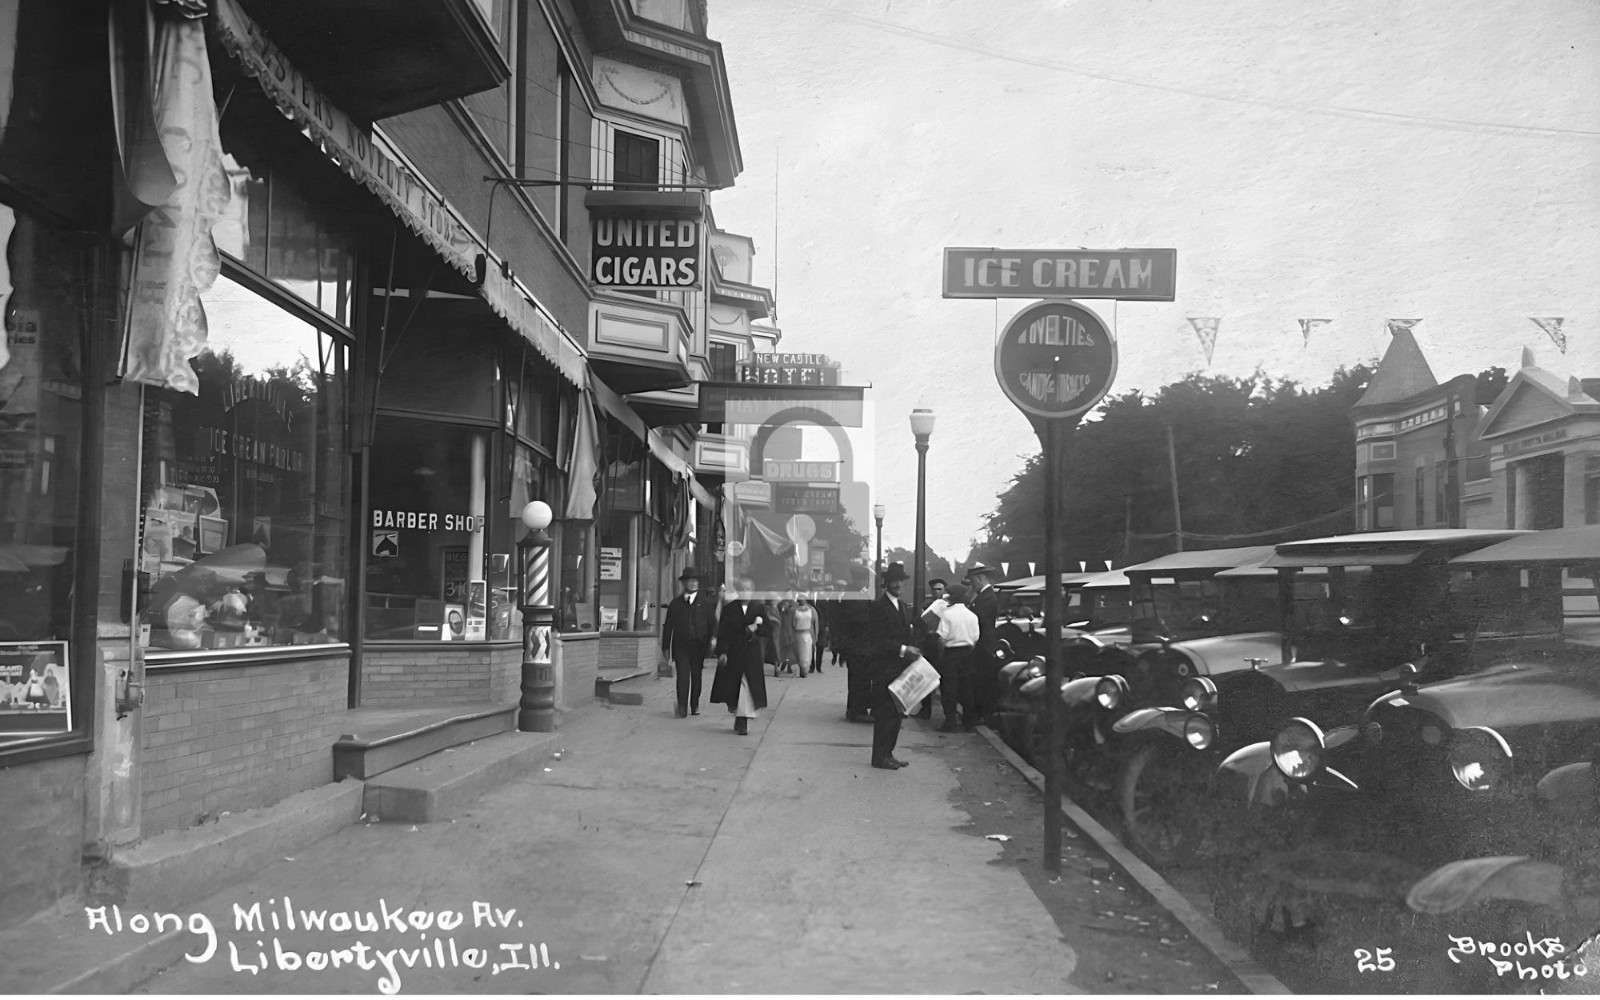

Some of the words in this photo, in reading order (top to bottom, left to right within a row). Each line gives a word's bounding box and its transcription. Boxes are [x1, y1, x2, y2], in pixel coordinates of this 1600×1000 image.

[346, 121, 412, 205] NOVELTY
[597, 219, 695, 247] UNITED
[596, 256, 695, 285] CIGARS
[964, 258, 1021, 287] ICE
[1032, 258, 1152, 289] CREAM
[1017, 314, 1095, 346] NOVELTIES
[756, 354, 779, 364] NEW
[210, 427, 228, 455] ICE
[766, 462, 832, 478] DRUGS
[373, 509, 438, 530] BARBER
[445, 513, 485, 533] SHOP
